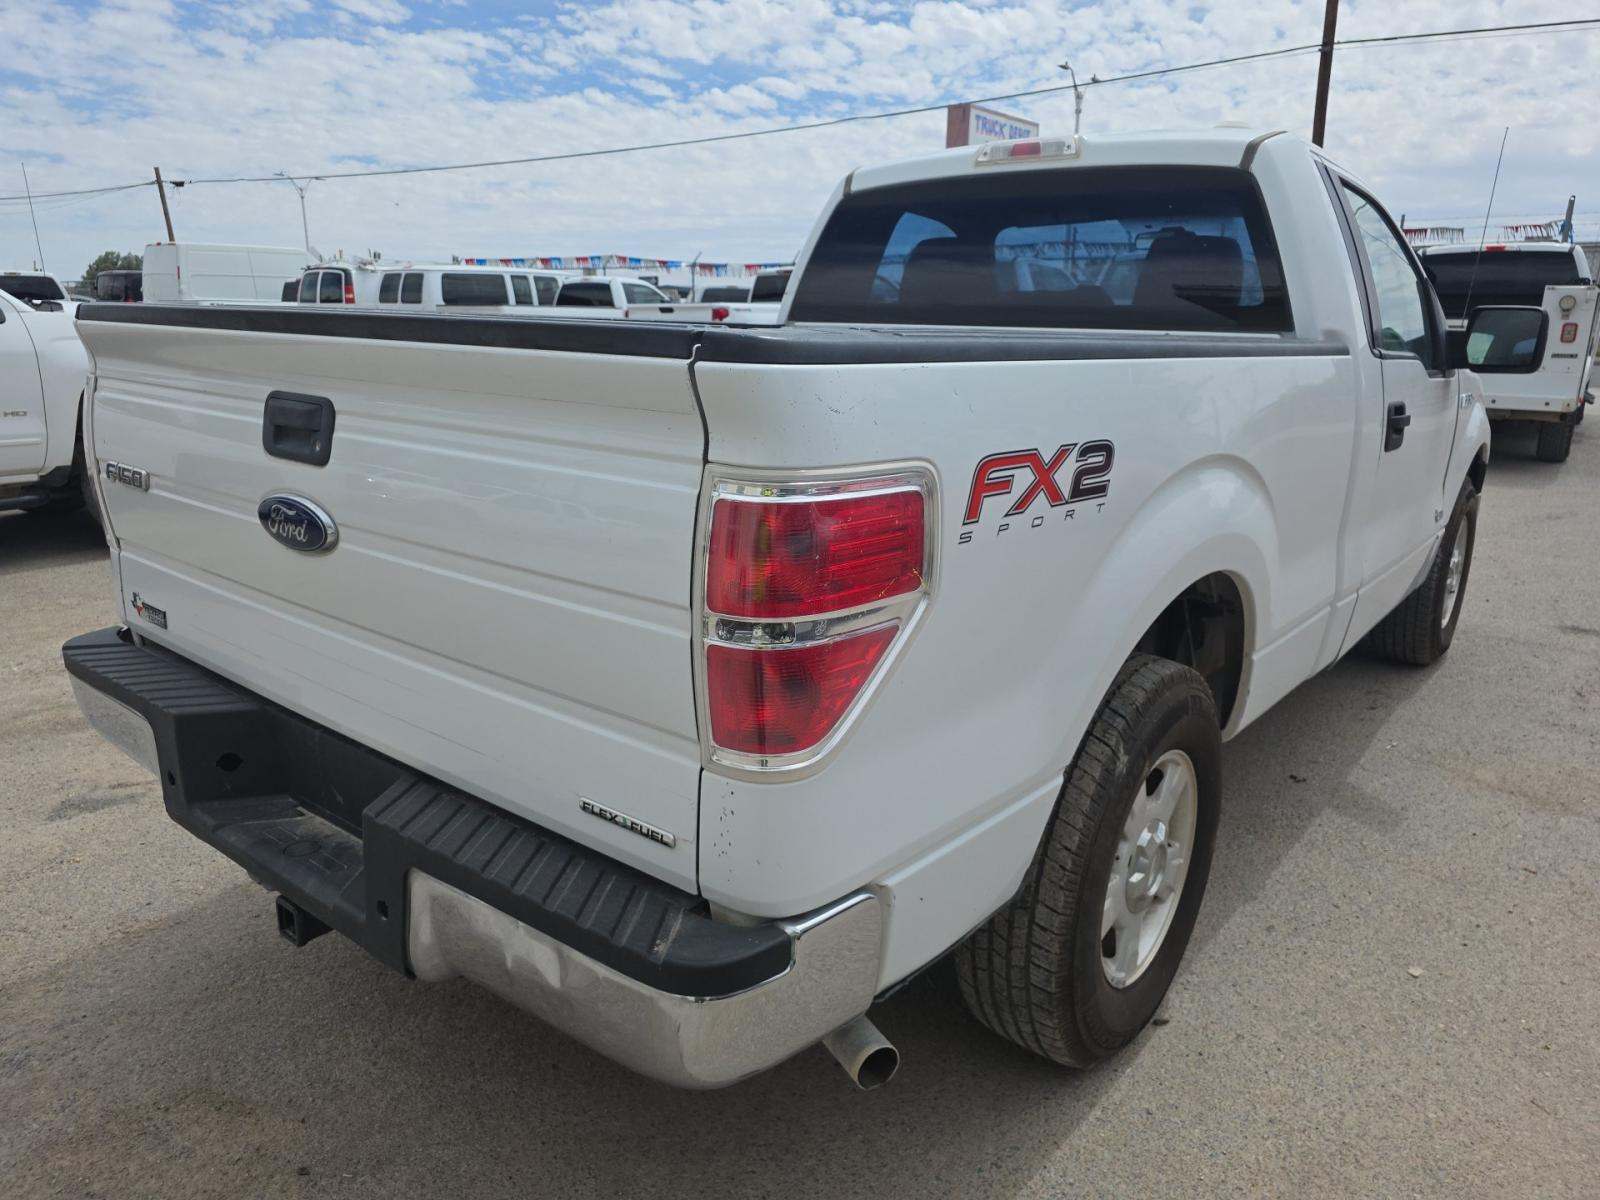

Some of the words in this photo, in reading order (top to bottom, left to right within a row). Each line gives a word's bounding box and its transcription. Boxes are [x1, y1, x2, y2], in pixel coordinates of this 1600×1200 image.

[975, 114, 1006, 139] TRUCK
[962, 439, 1115, 525] FX2
[268, 504, 309, 542] Ford
[958, 502, 1106, 545] SPORT
[582, 800, 620, 823] FLEX
[629, 819, 671, 846] FUEL
